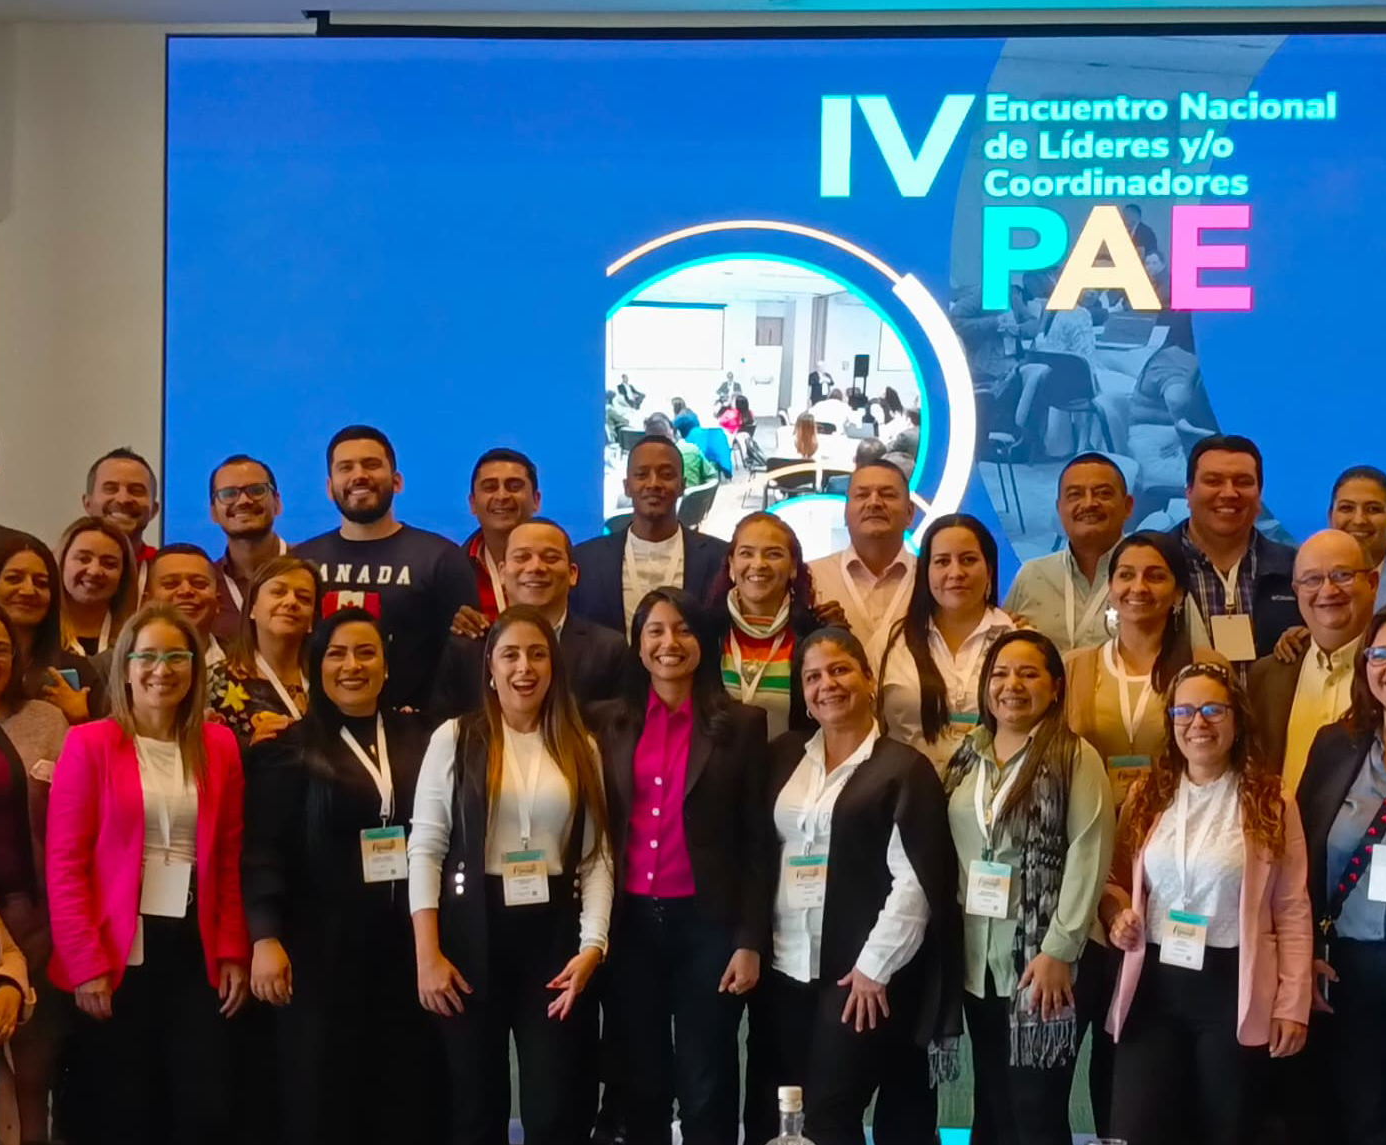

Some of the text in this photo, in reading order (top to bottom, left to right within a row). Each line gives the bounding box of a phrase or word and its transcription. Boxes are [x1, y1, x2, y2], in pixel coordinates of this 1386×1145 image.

[985, 90, 1337, 122] Encuentro Nacional
[820, 93, 976, 197] IV
[983, 128, 1235, 165] de Líderes y/o
[983, 166, 1249, 198] Coordinadores
[981, 204, 1253, 311] PAE
[319, 562, 411, 585] ANADA
